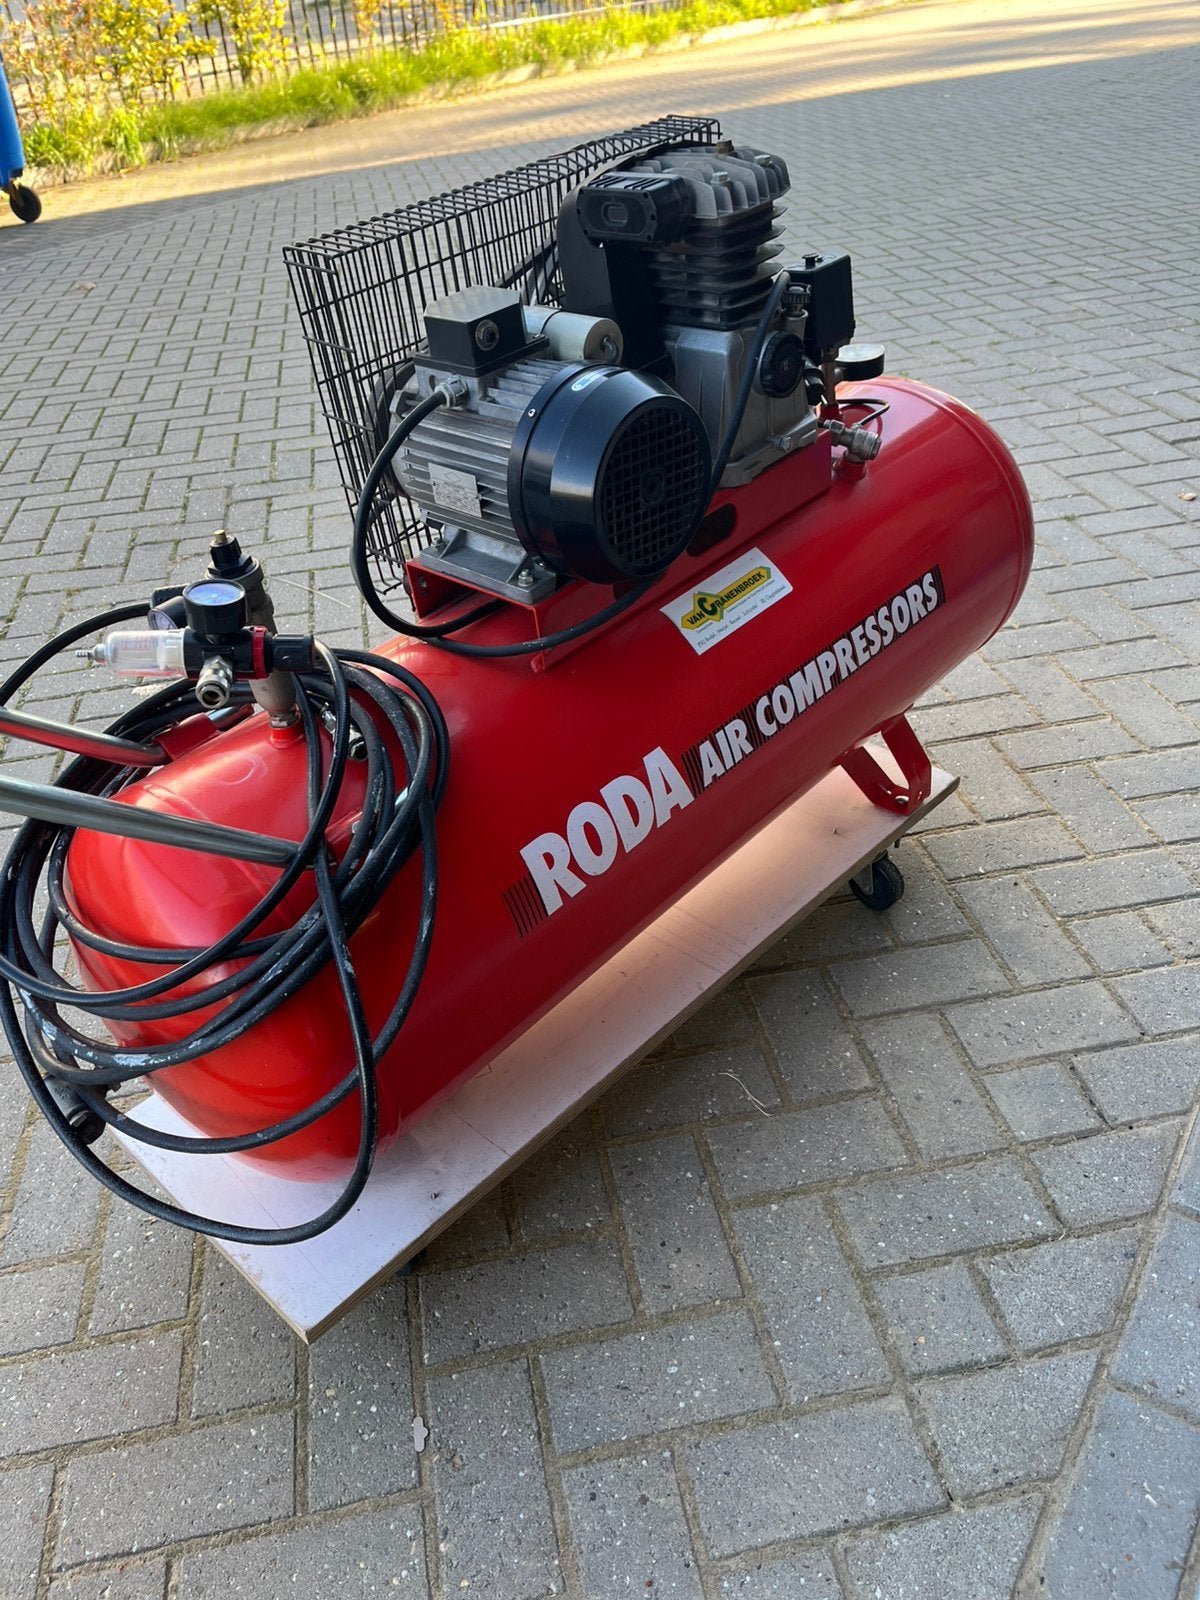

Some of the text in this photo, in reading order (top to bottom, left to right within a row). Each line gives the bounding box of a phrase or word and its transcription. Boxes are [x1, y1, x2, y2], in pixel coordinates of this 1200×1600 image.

[687, 610, 706, 625] VAN
[697, 571, 765, 616] CRANENBROEK
[520, 572, 939, 916] RODA AIR COMPRESSORS
